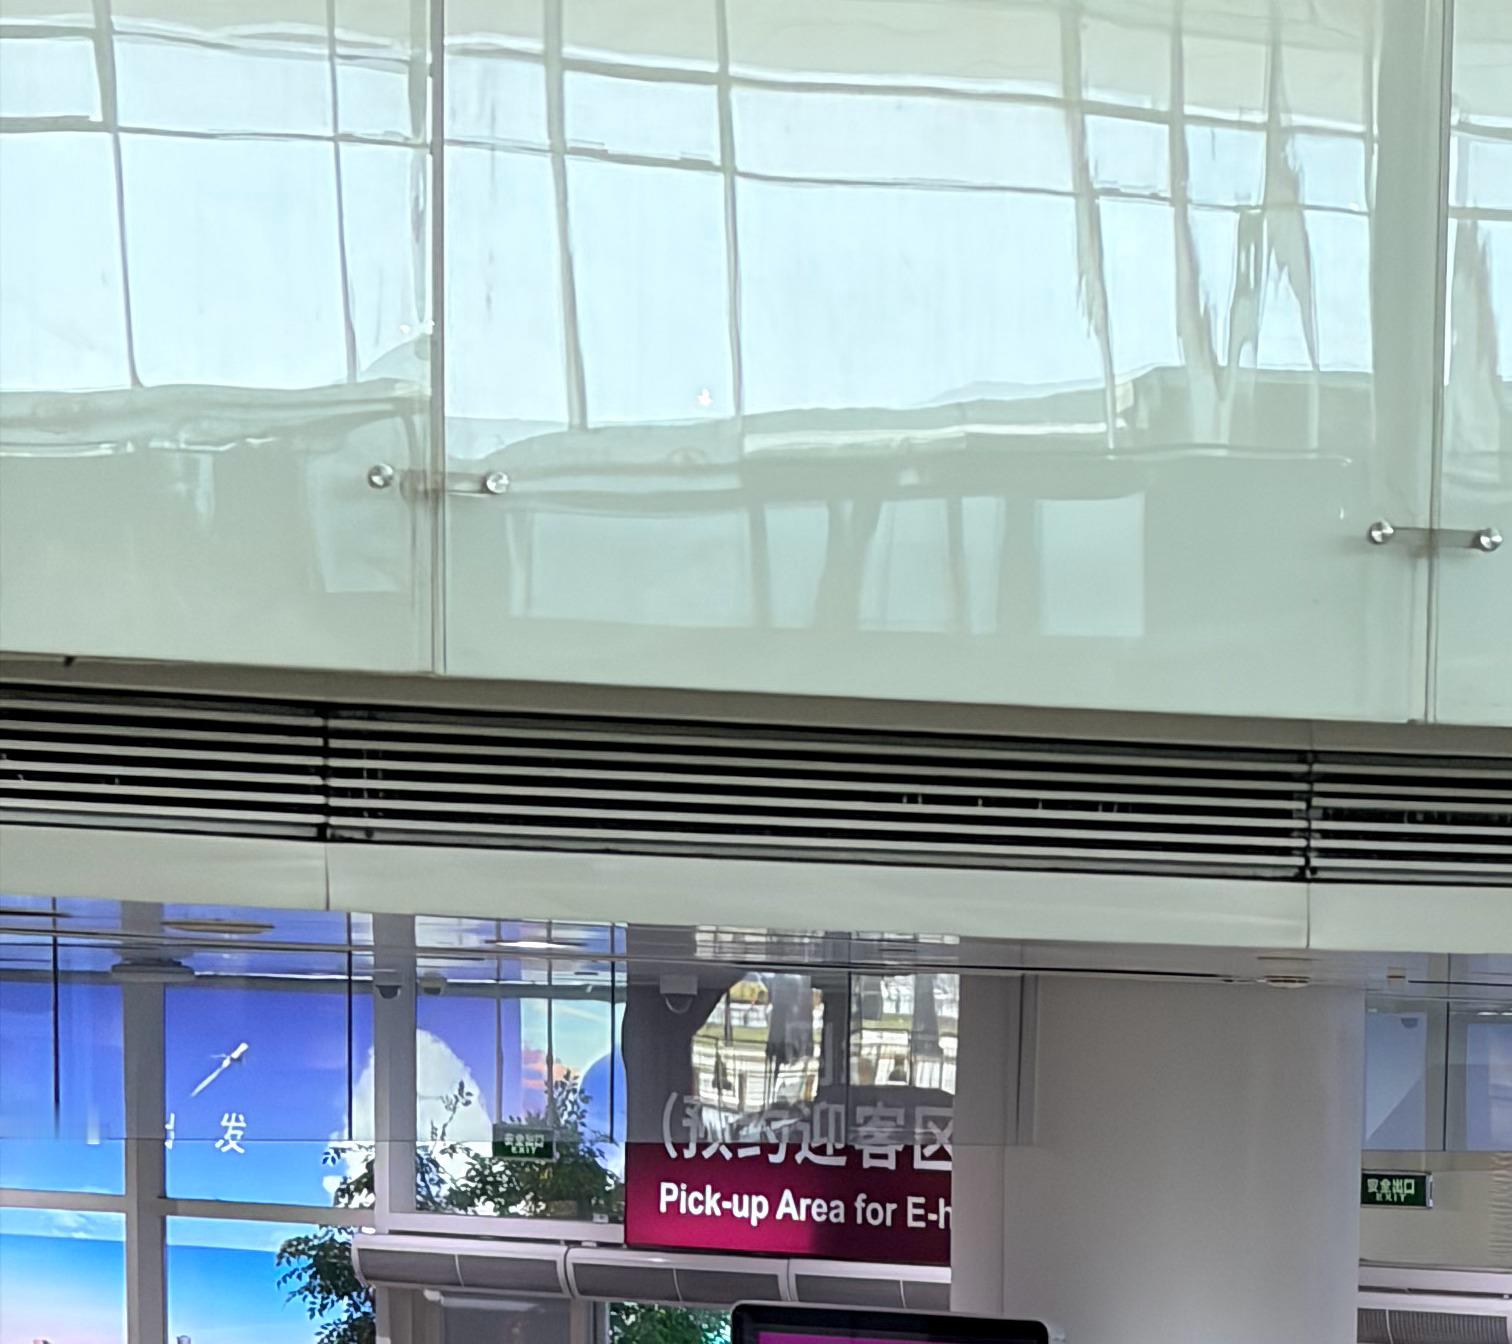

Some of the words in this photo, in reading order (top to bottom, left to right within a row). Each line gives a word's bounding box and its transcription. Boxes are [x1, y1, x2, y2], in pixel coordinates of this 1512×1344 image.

[659, 1181, 769, 1227] Pick-up
[775, 1188, 846, 1224] Area
[855, 1193, 897, 1226] for
